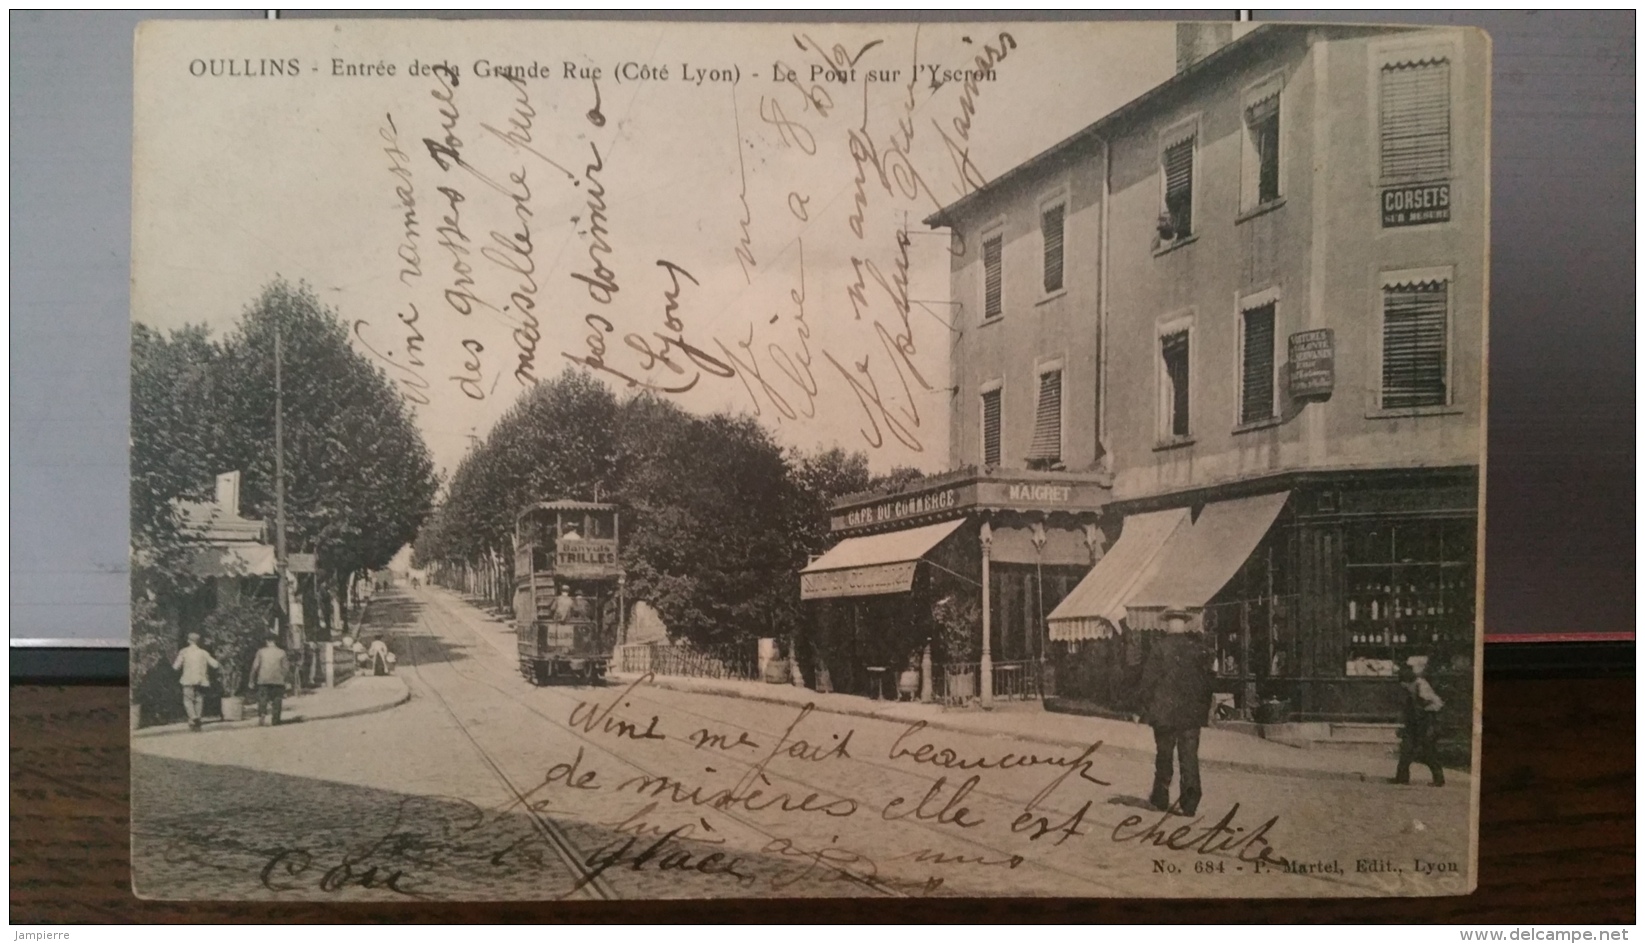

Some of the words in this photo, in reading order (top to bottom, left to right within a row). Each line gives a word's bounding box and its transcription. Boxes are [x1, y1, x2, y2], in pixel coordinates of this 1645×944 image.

[189, 58, 300, 77] OULLINS
[331, 57, 396, 77] Entrée
[408, 59, 430, 77] de
[473, 60, 550, 80] Grande
[563, 61, 602, 80] Rue
[614, 61, 669, 84] (Côté
[682, 63, 741, 86] Lyon)
[772, 64, 797, 83] Le
[810, 64, 856, 83] Pont
[868, 69, 901, 83] sur
[1385, 186, 1449, 211] CORSETS
[877, 503, 892, 521] DU
[894, 489, 955, 516] COMMERCE
[559, 552, 614, 564] TRILLES
[1152, 859, 1182, 874] No.
[1194, 860, 1226, 874] 684
[1253, 860, 1271, 874] P.
[1283, 860, 1345, 875] Martel,
[1415, 859, 1459, 875] Lyon
